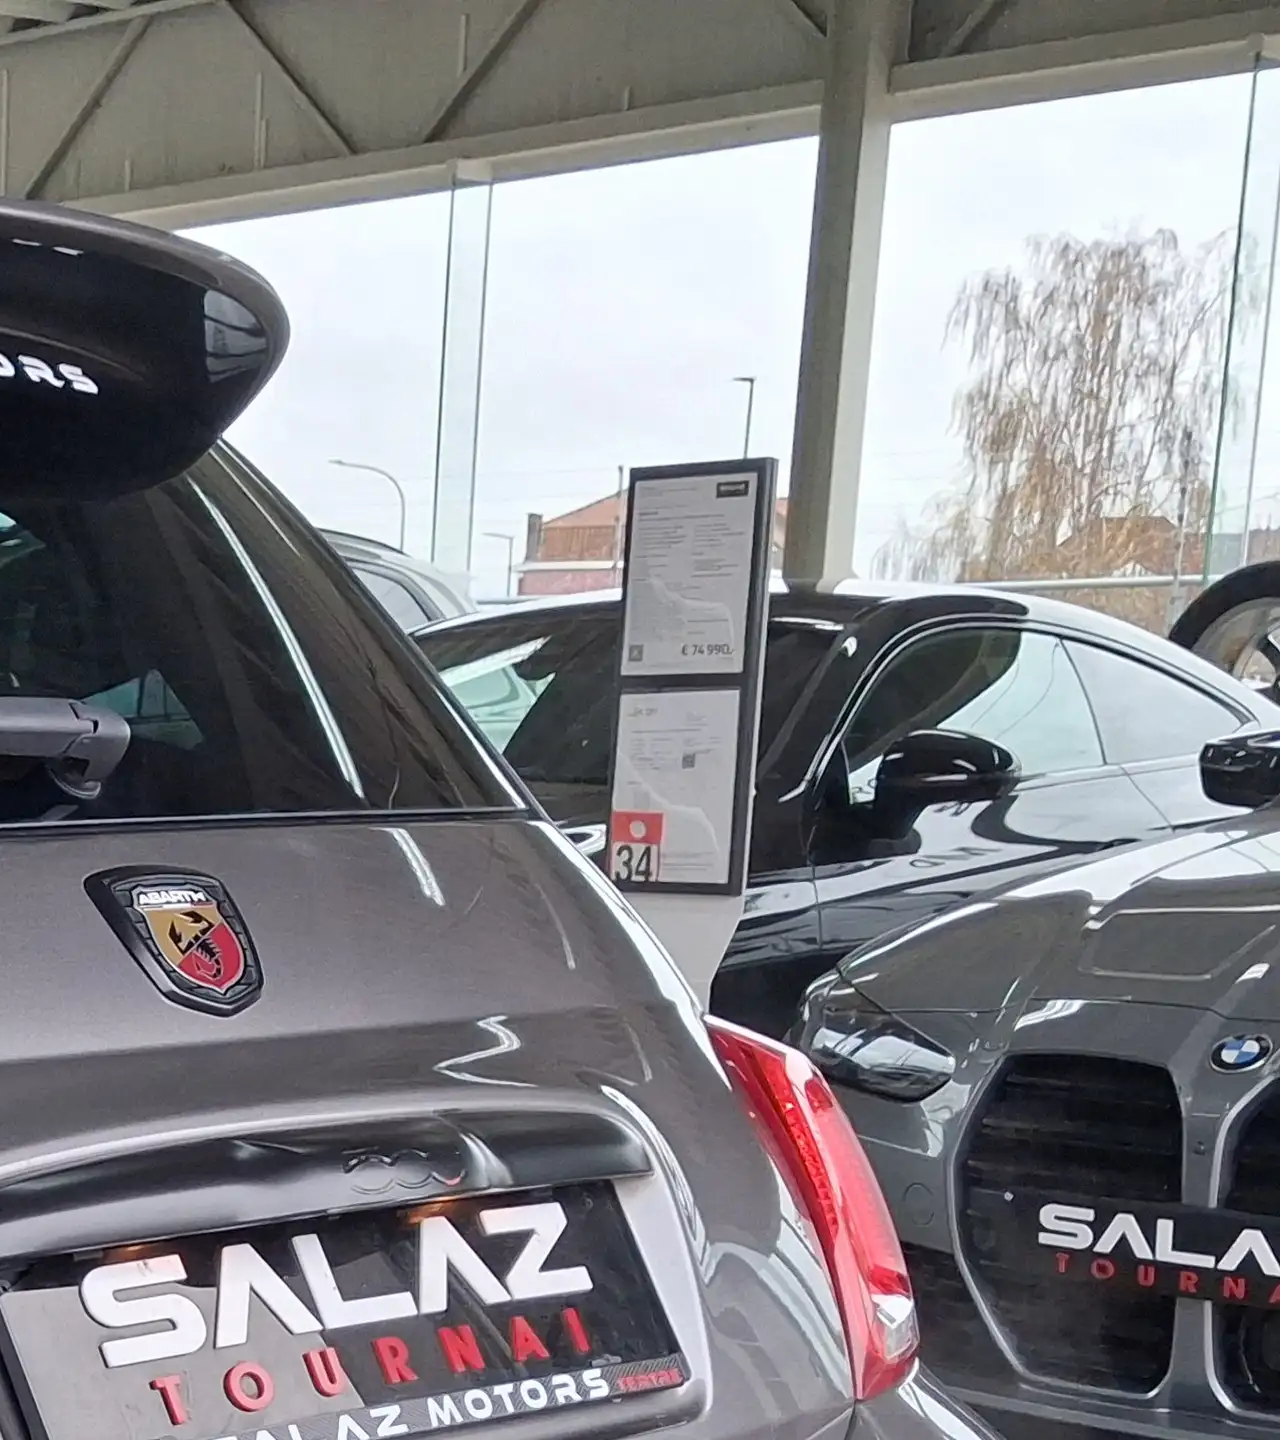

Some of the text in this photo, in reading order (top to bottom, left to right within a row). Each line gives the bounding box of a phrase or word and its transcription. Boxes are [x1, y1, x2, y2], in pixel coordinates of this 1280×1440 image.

[615, 845, 653, 882] 34
[139, 889, 207, 905] ABARTH
[81, 1202, 594, 1367] SALAZ
[148, 1307, 591, 1426] TOURNAI
[427, 1368, 611, 1429] MOTORS
